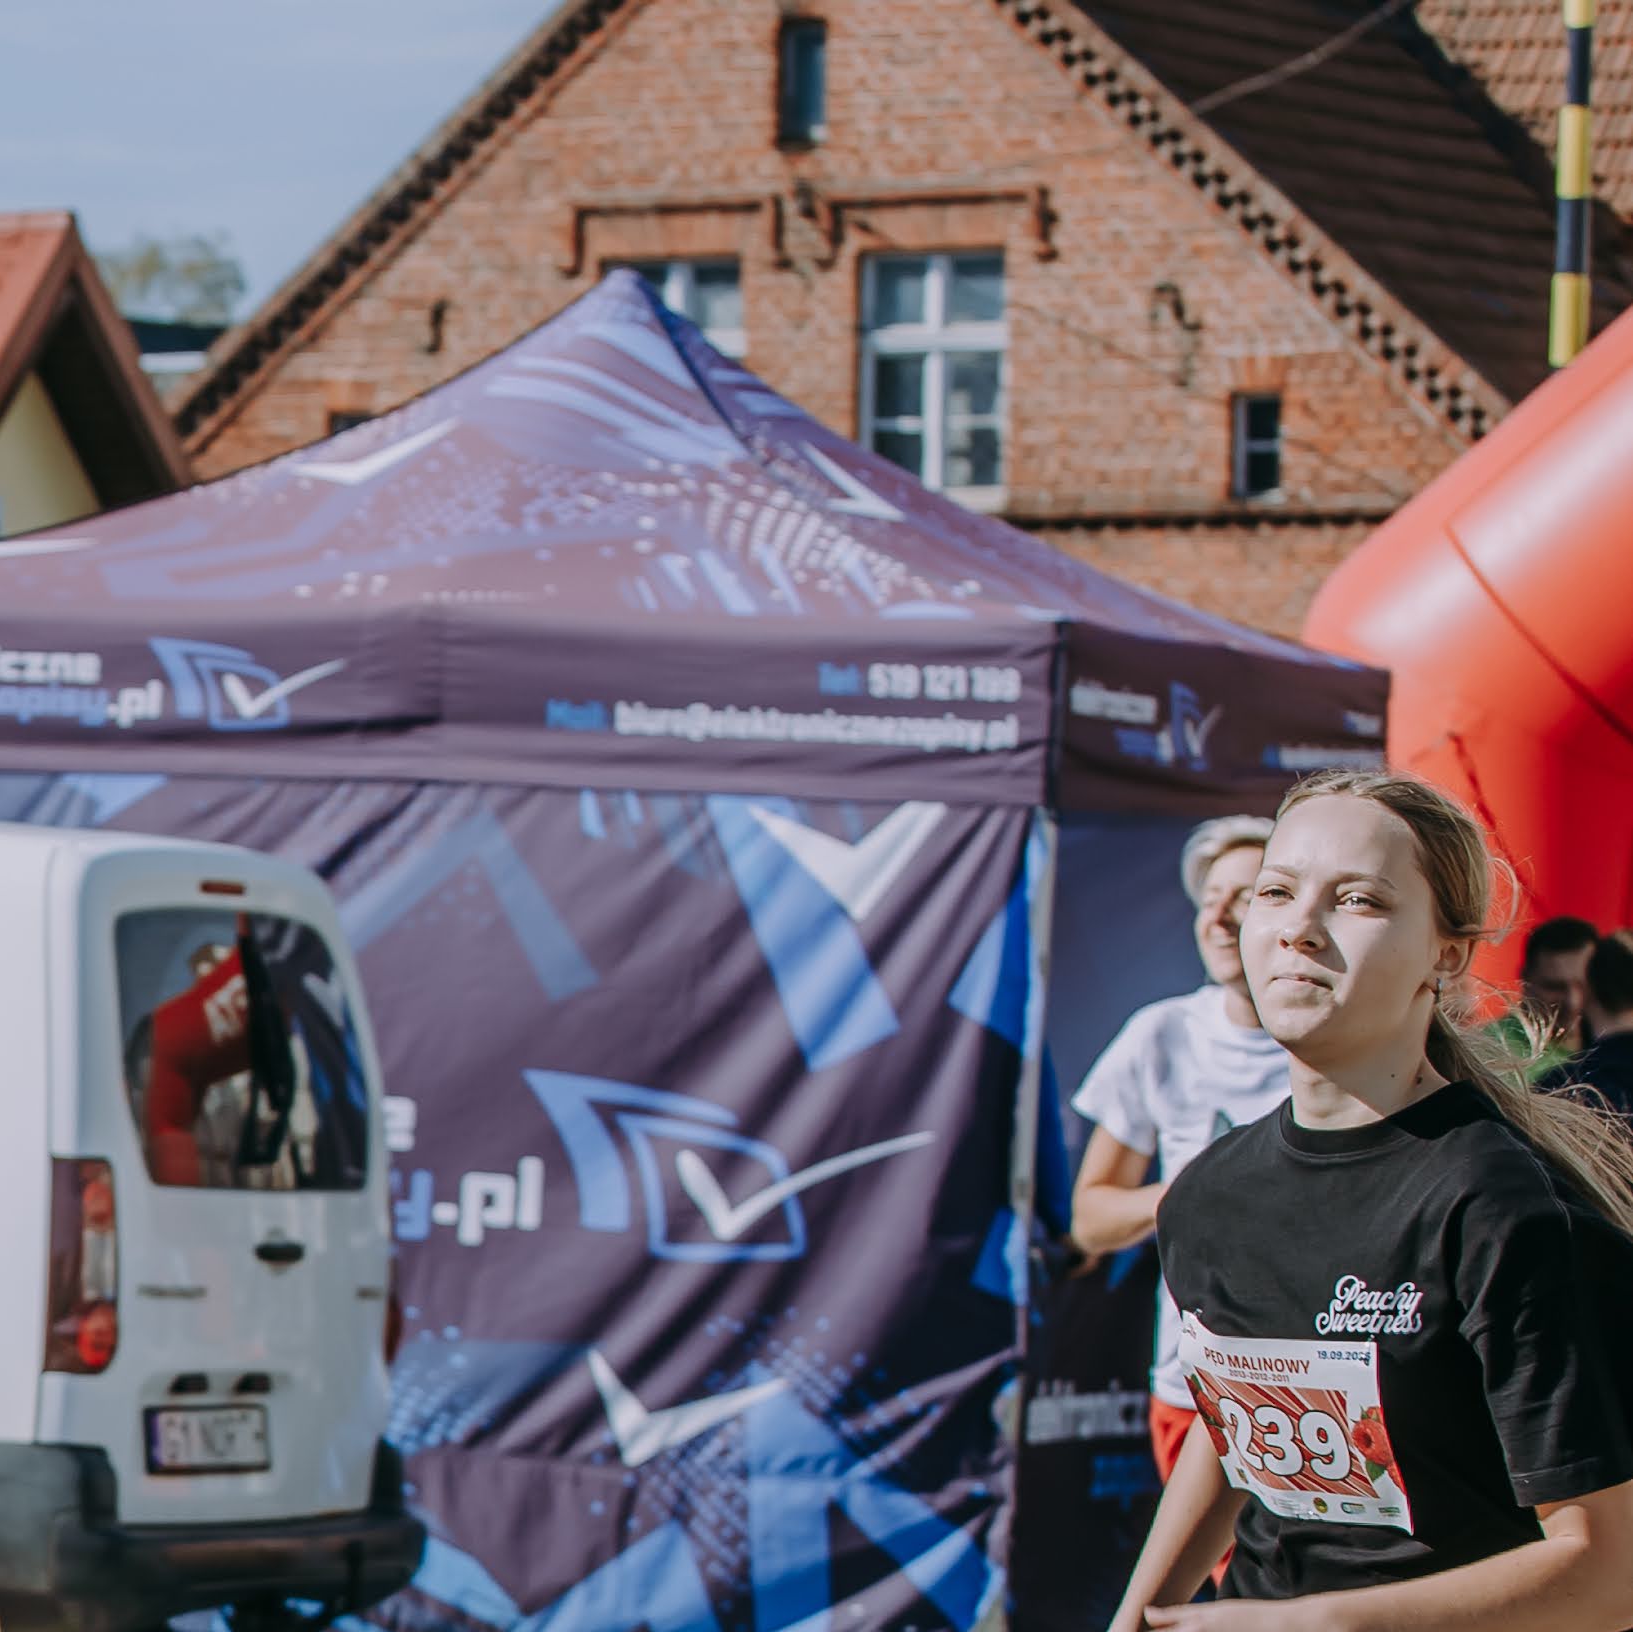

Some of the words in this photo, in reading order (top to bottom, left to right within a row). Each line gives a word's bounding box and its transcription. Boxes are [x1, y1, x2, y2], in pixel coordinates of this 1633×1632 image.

[1334, 1274, 1424, 1318] Peachy
[1315, 1299, 1423, 1336] Sweetness
[1203, 1346, 1226, 1366] PĘD
[1228, 1355, 1311, 1376] MALINOWY
[1227, 1368, 1291, 1383] 2013-2012-2011
[1216, 1394, 1353, 1482] 239
